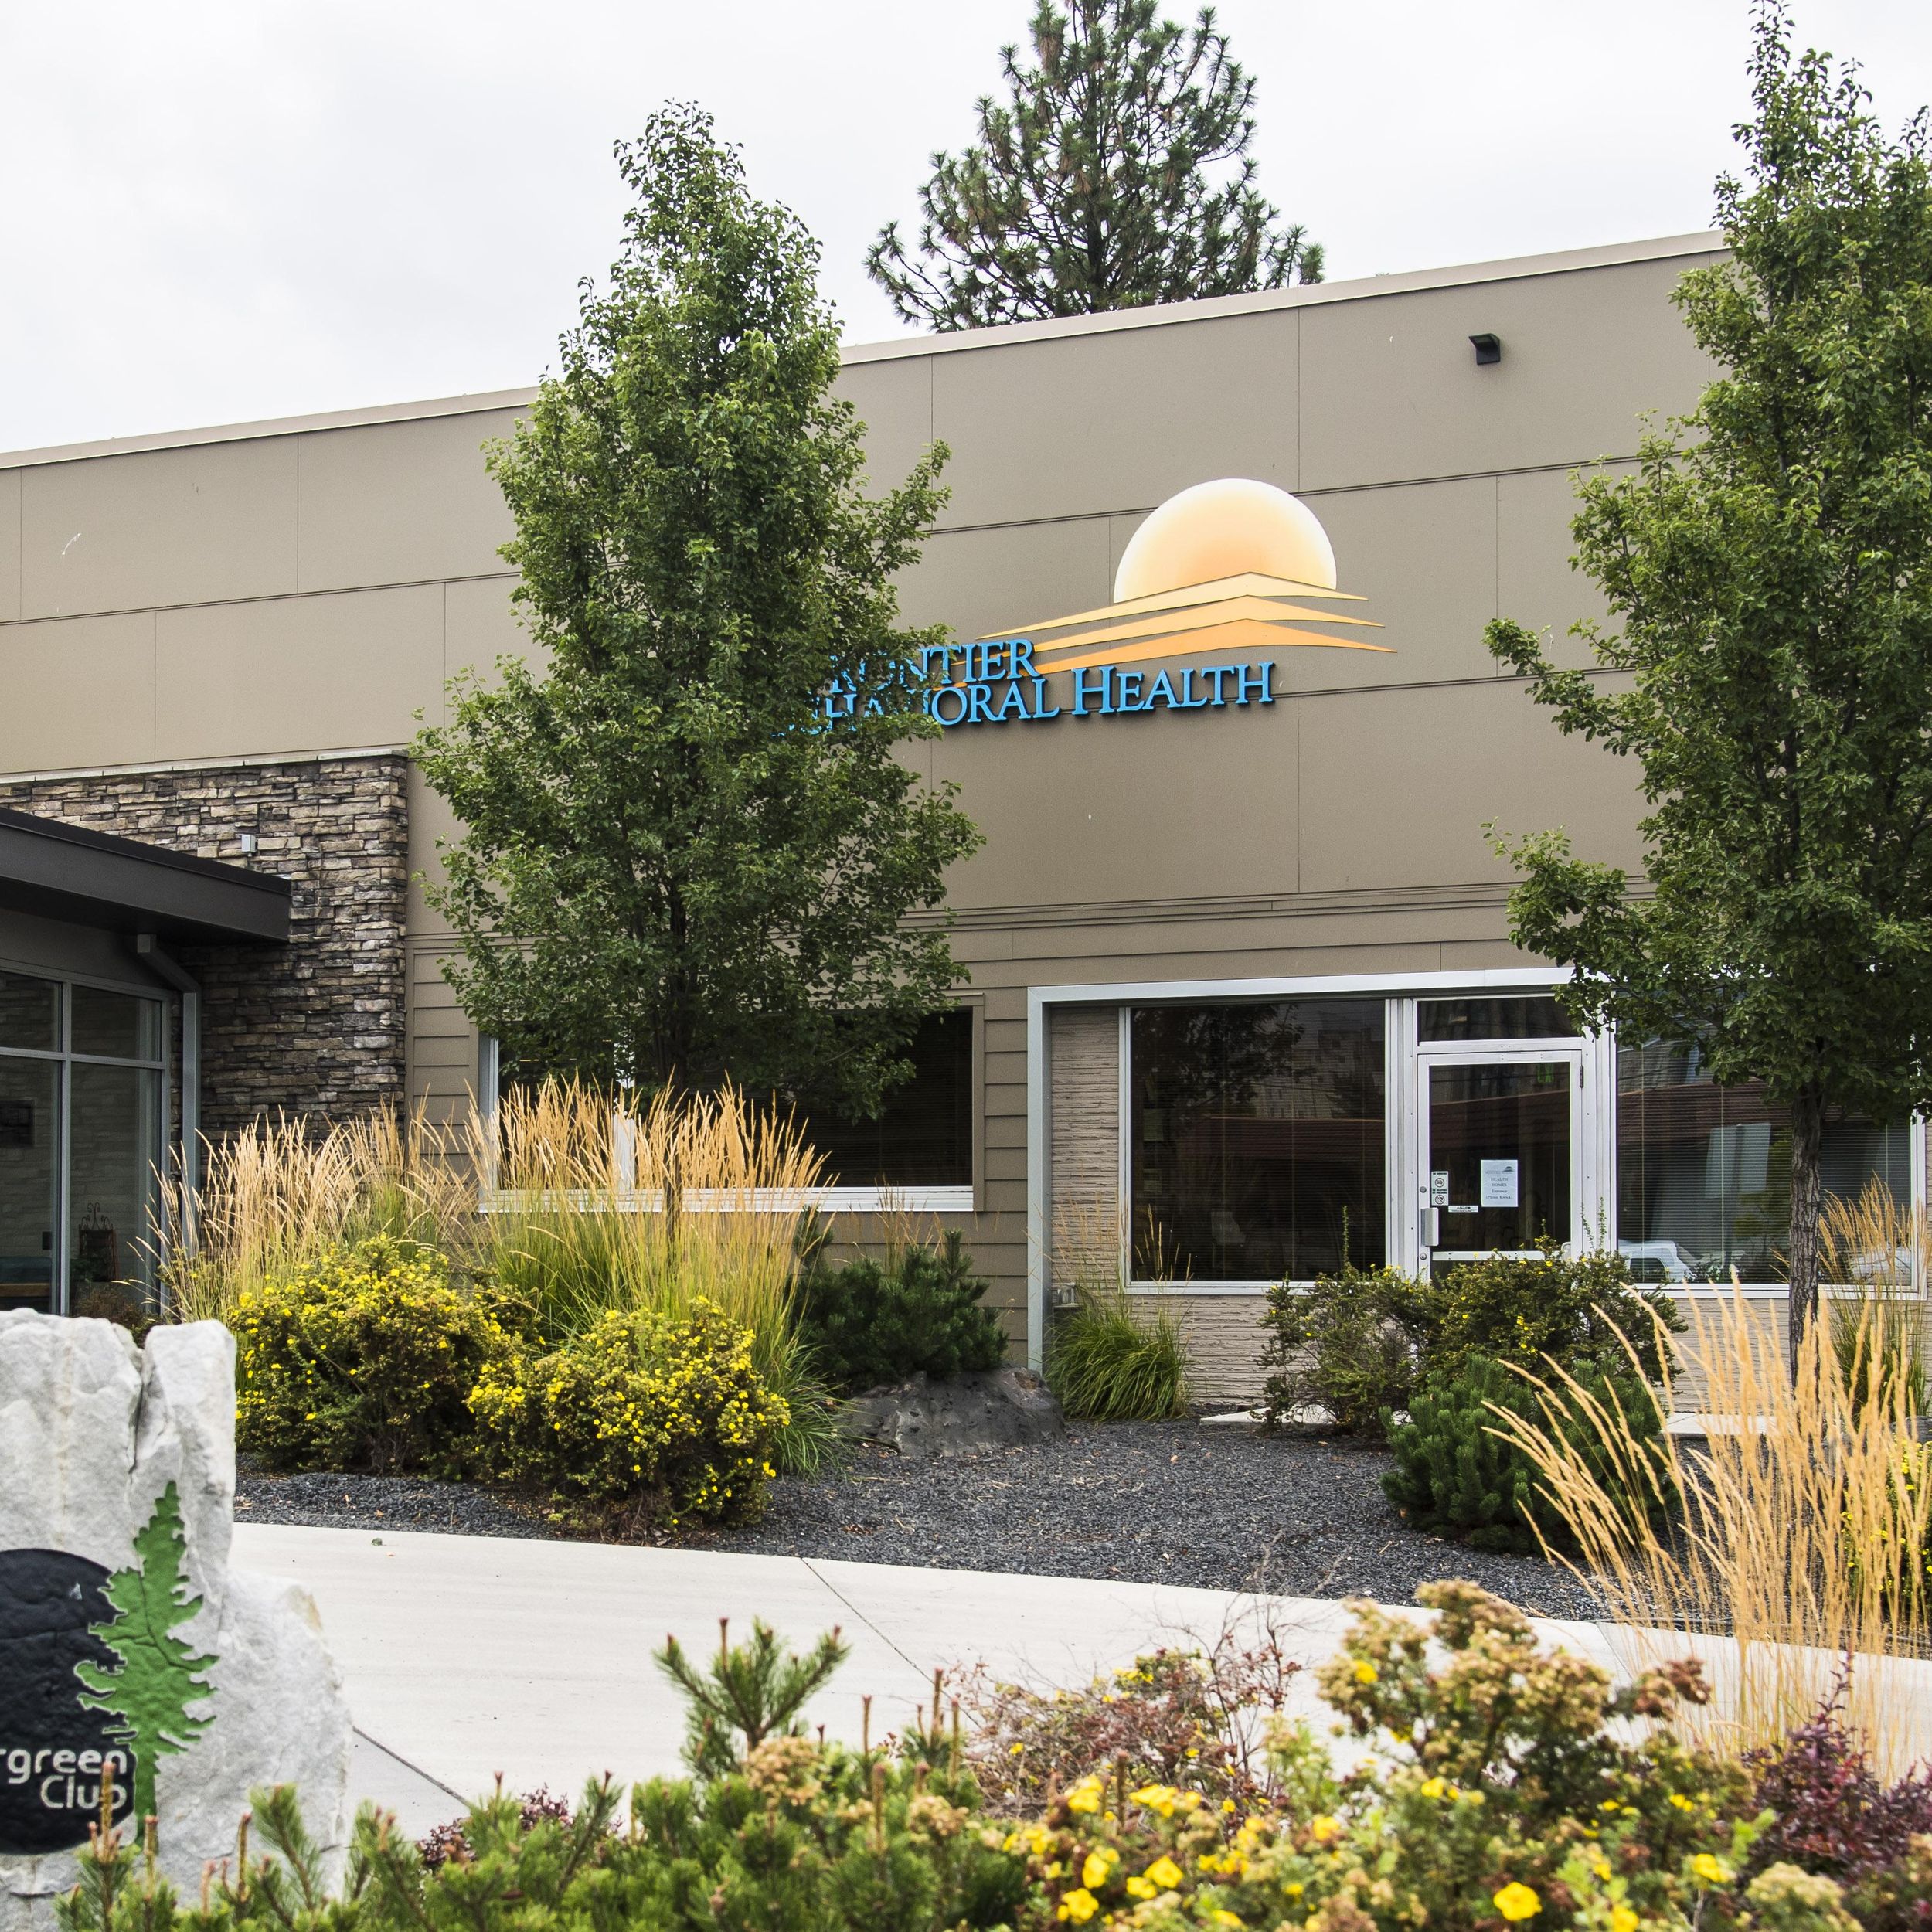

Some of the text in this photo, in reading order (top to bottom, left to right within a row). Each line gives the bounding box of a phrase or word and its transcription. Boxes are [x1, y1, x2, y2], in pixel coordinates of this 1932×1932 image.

[807, 638, 1041, 694] NTIER
[1071, 661, 1274, 716] HEALTH
[0, 1749, 127, 1784] green
